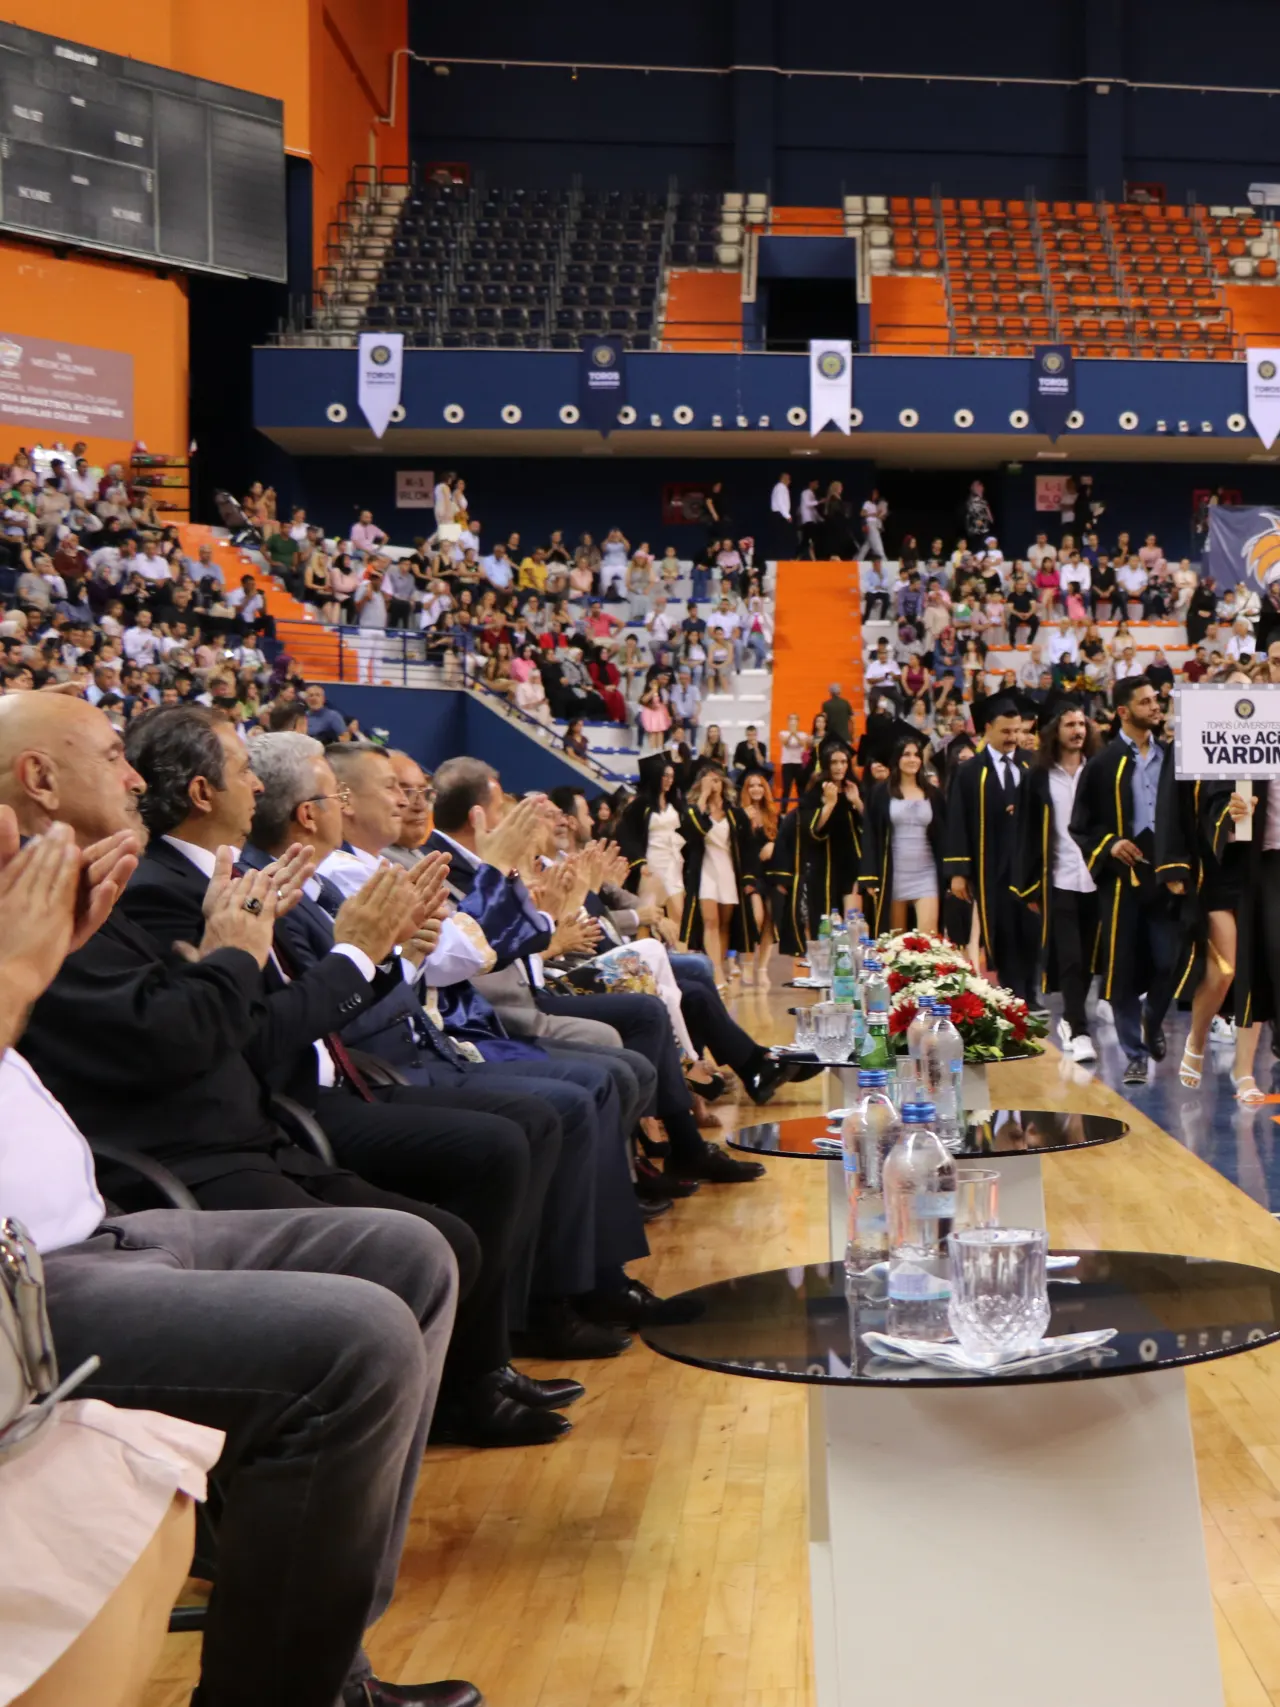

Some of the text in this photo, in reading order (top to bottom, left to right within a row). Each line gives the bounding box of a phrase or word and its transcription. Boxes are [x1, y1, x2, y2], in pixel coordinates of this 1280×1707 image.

[588, 372, 621, 381] TOROS
[1038, 378, 1069, 387] TOROS
[1206, 721, 1232, 729] TOROS
[1231, 734, 1251, 744] ve
